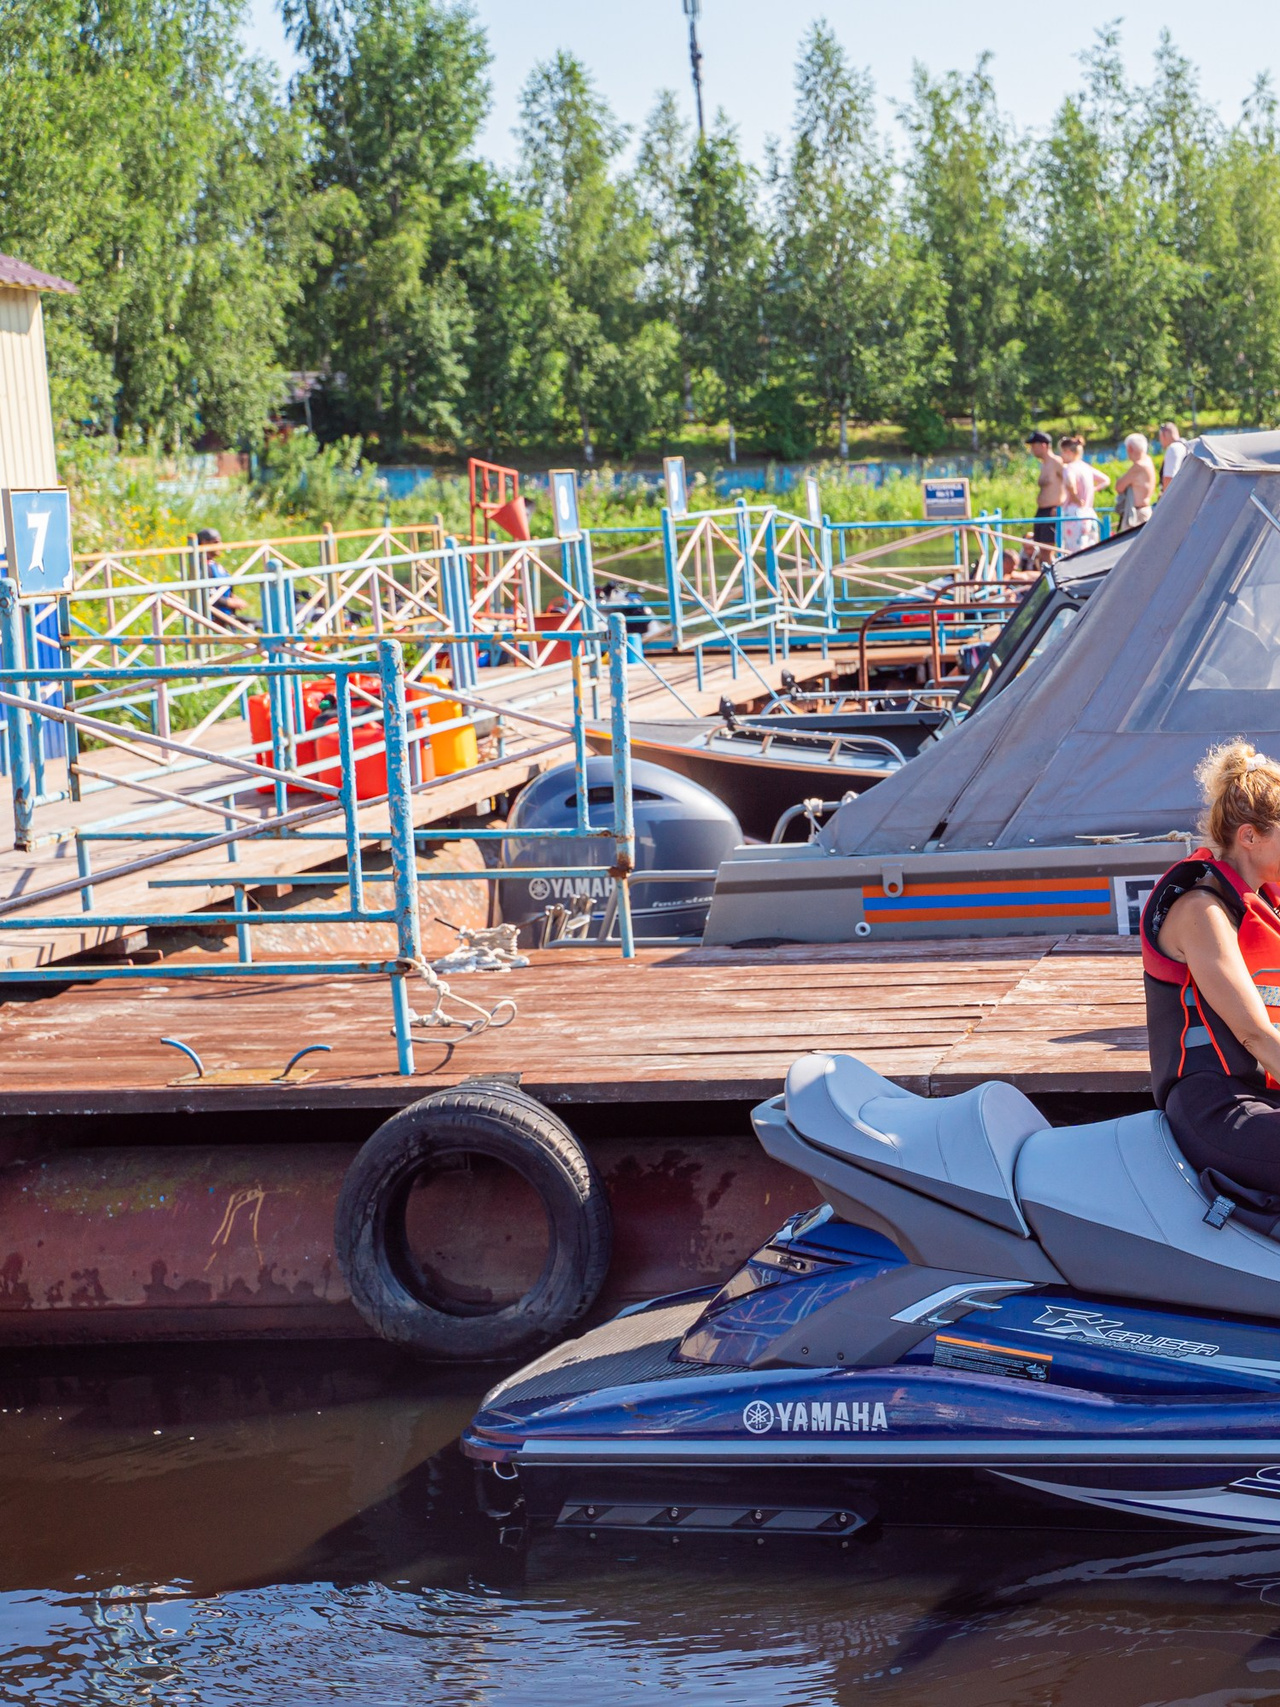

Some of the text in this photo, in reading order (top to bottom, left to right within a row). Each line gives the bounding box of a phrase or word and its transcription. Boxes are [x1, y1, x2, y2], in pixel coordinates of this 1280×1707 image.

[26, 510, 52, 574] 7
[550, 877, 618, 899] YAMAH
[1032, 1305, 1220, 1357] FX CRUISER
[776, 1401, 888, 1432] YAMAHA
